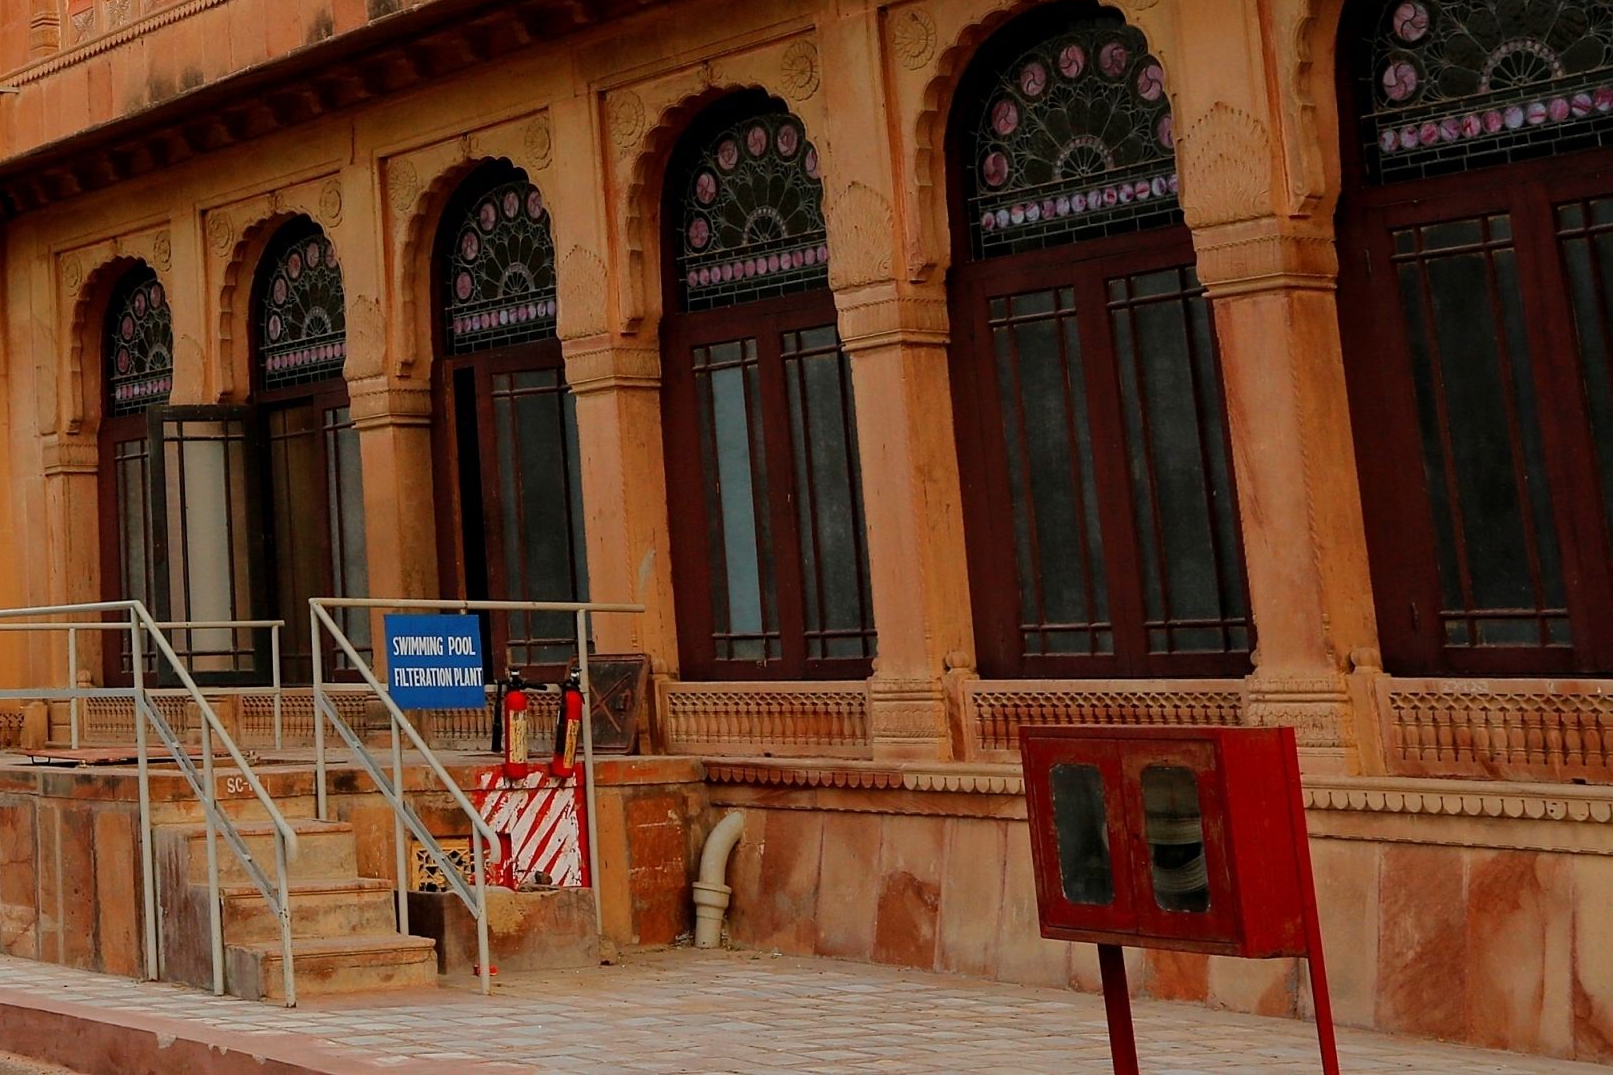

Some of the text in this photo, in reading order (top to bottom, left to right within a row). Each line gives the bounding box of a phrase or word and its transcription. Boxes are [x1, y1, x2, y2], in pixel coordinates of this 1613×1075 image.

[392, 636, 476, 656] SWIMMING POOL
[394, 667, 482, 687] FILTERATION PLANT
[227, 776, 260, 793] SC-
